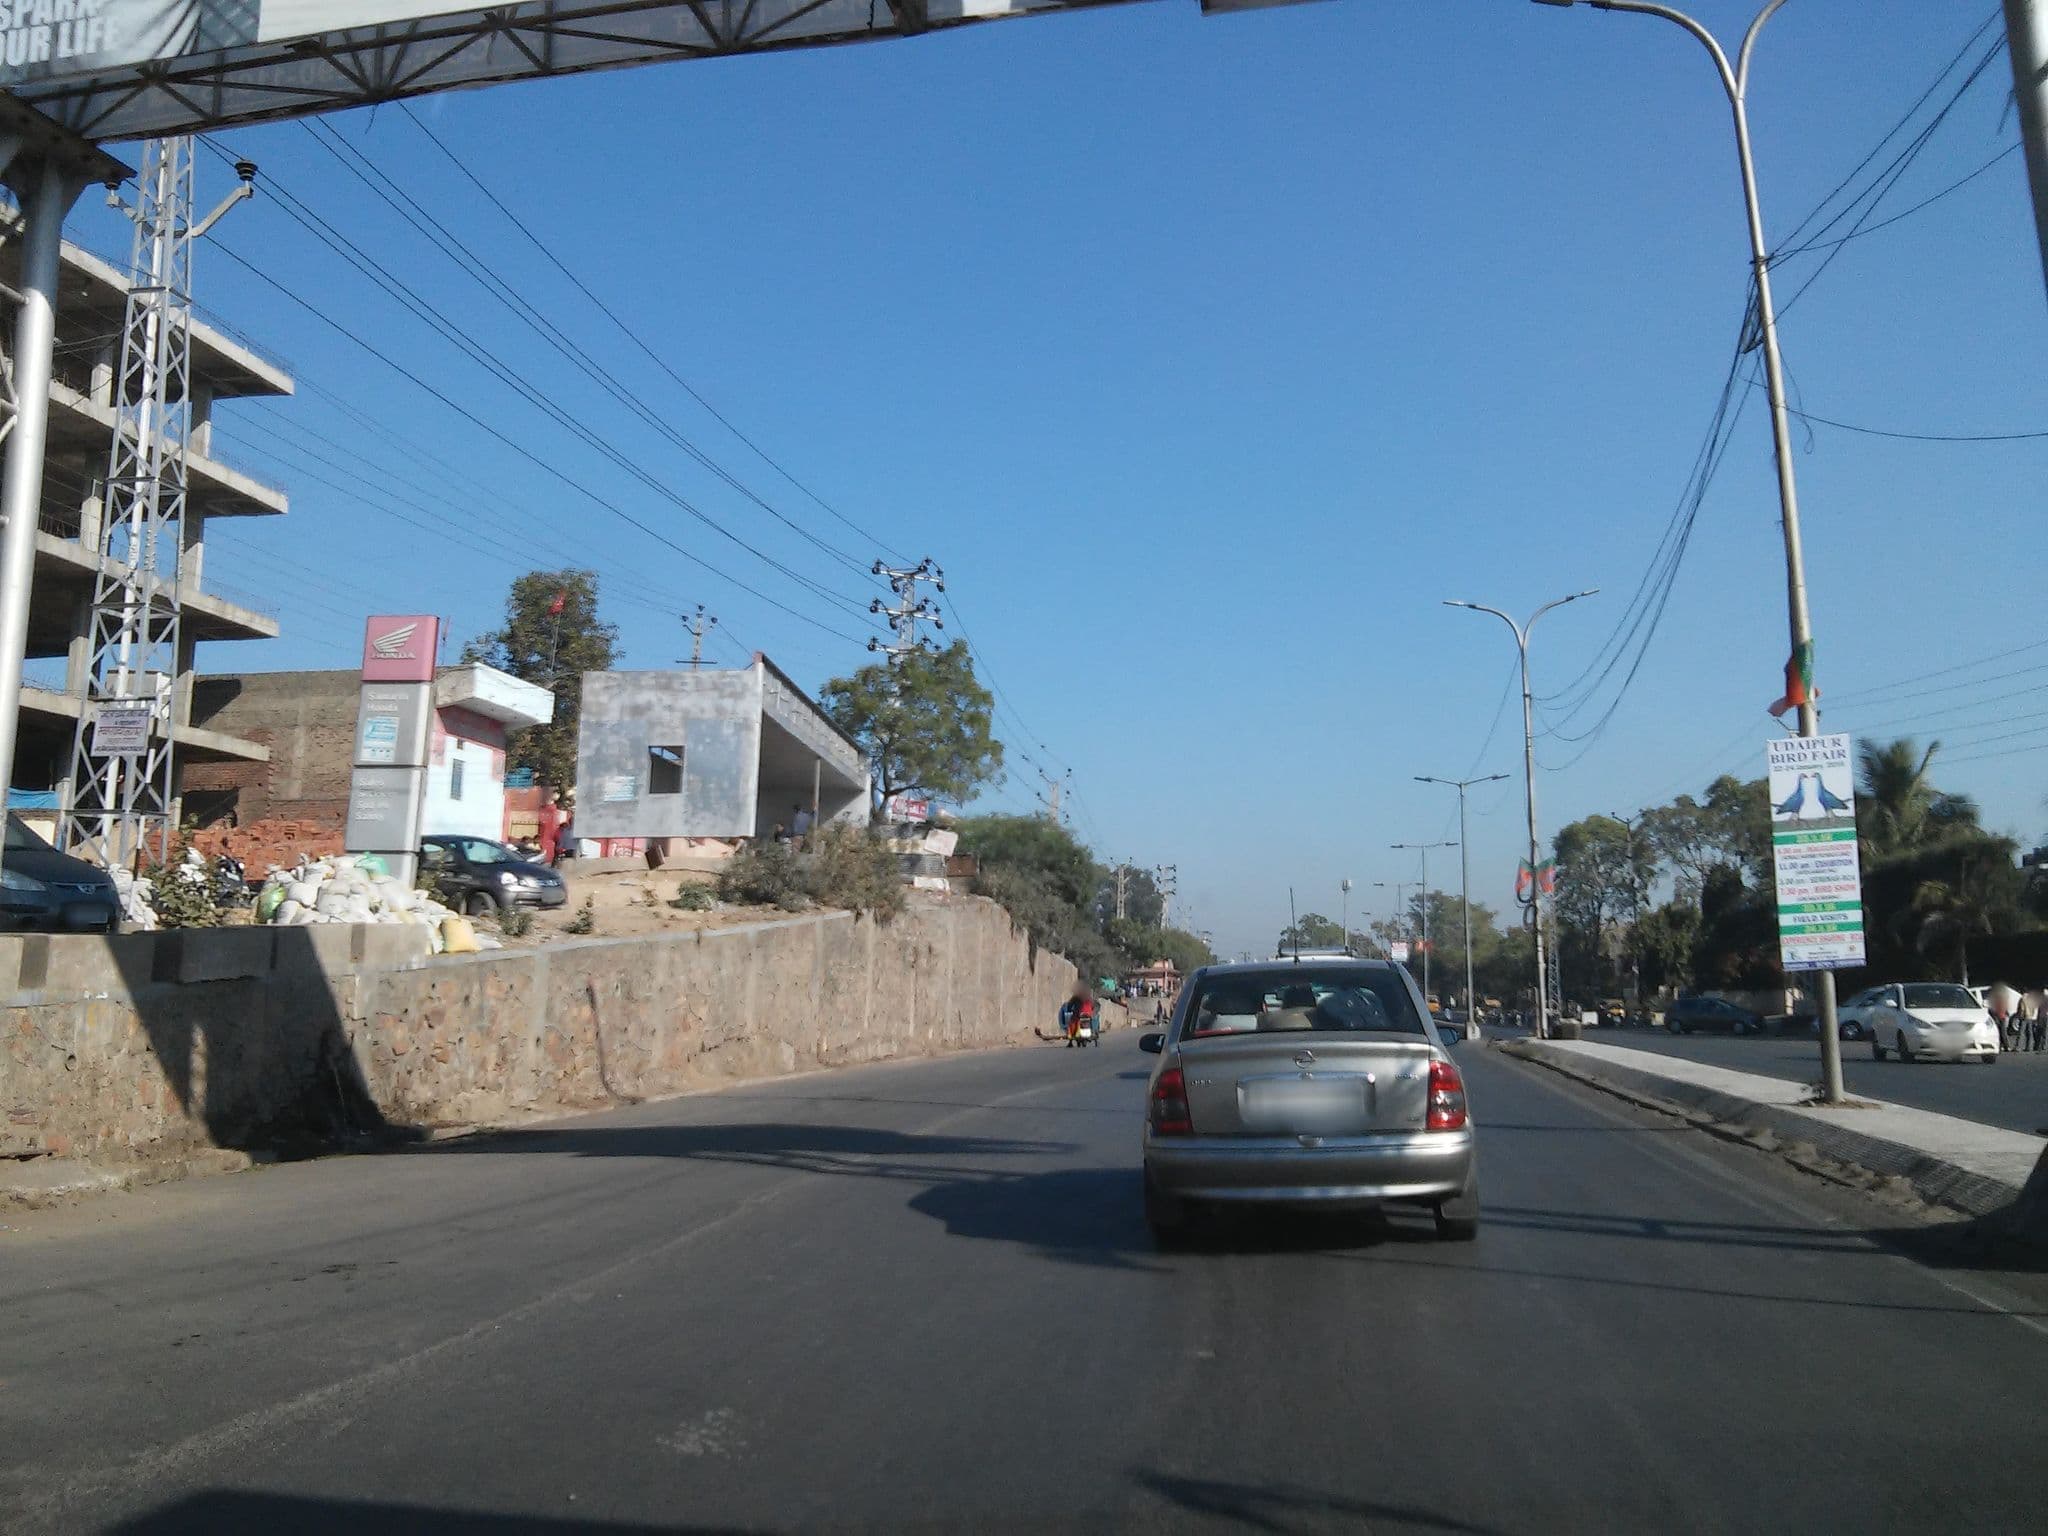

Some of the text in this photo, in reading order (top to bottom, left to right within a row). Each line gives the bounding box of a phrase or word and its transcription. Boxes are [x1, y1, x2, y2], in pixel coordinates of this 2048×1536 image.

[57, 15, 119, 58] LIFE
[370, 651, 417, 659] HONDA
[1773, 738, 1842, 752] UDAIPUR
[1770, 749, 1847, 764] BIRD FAIR
